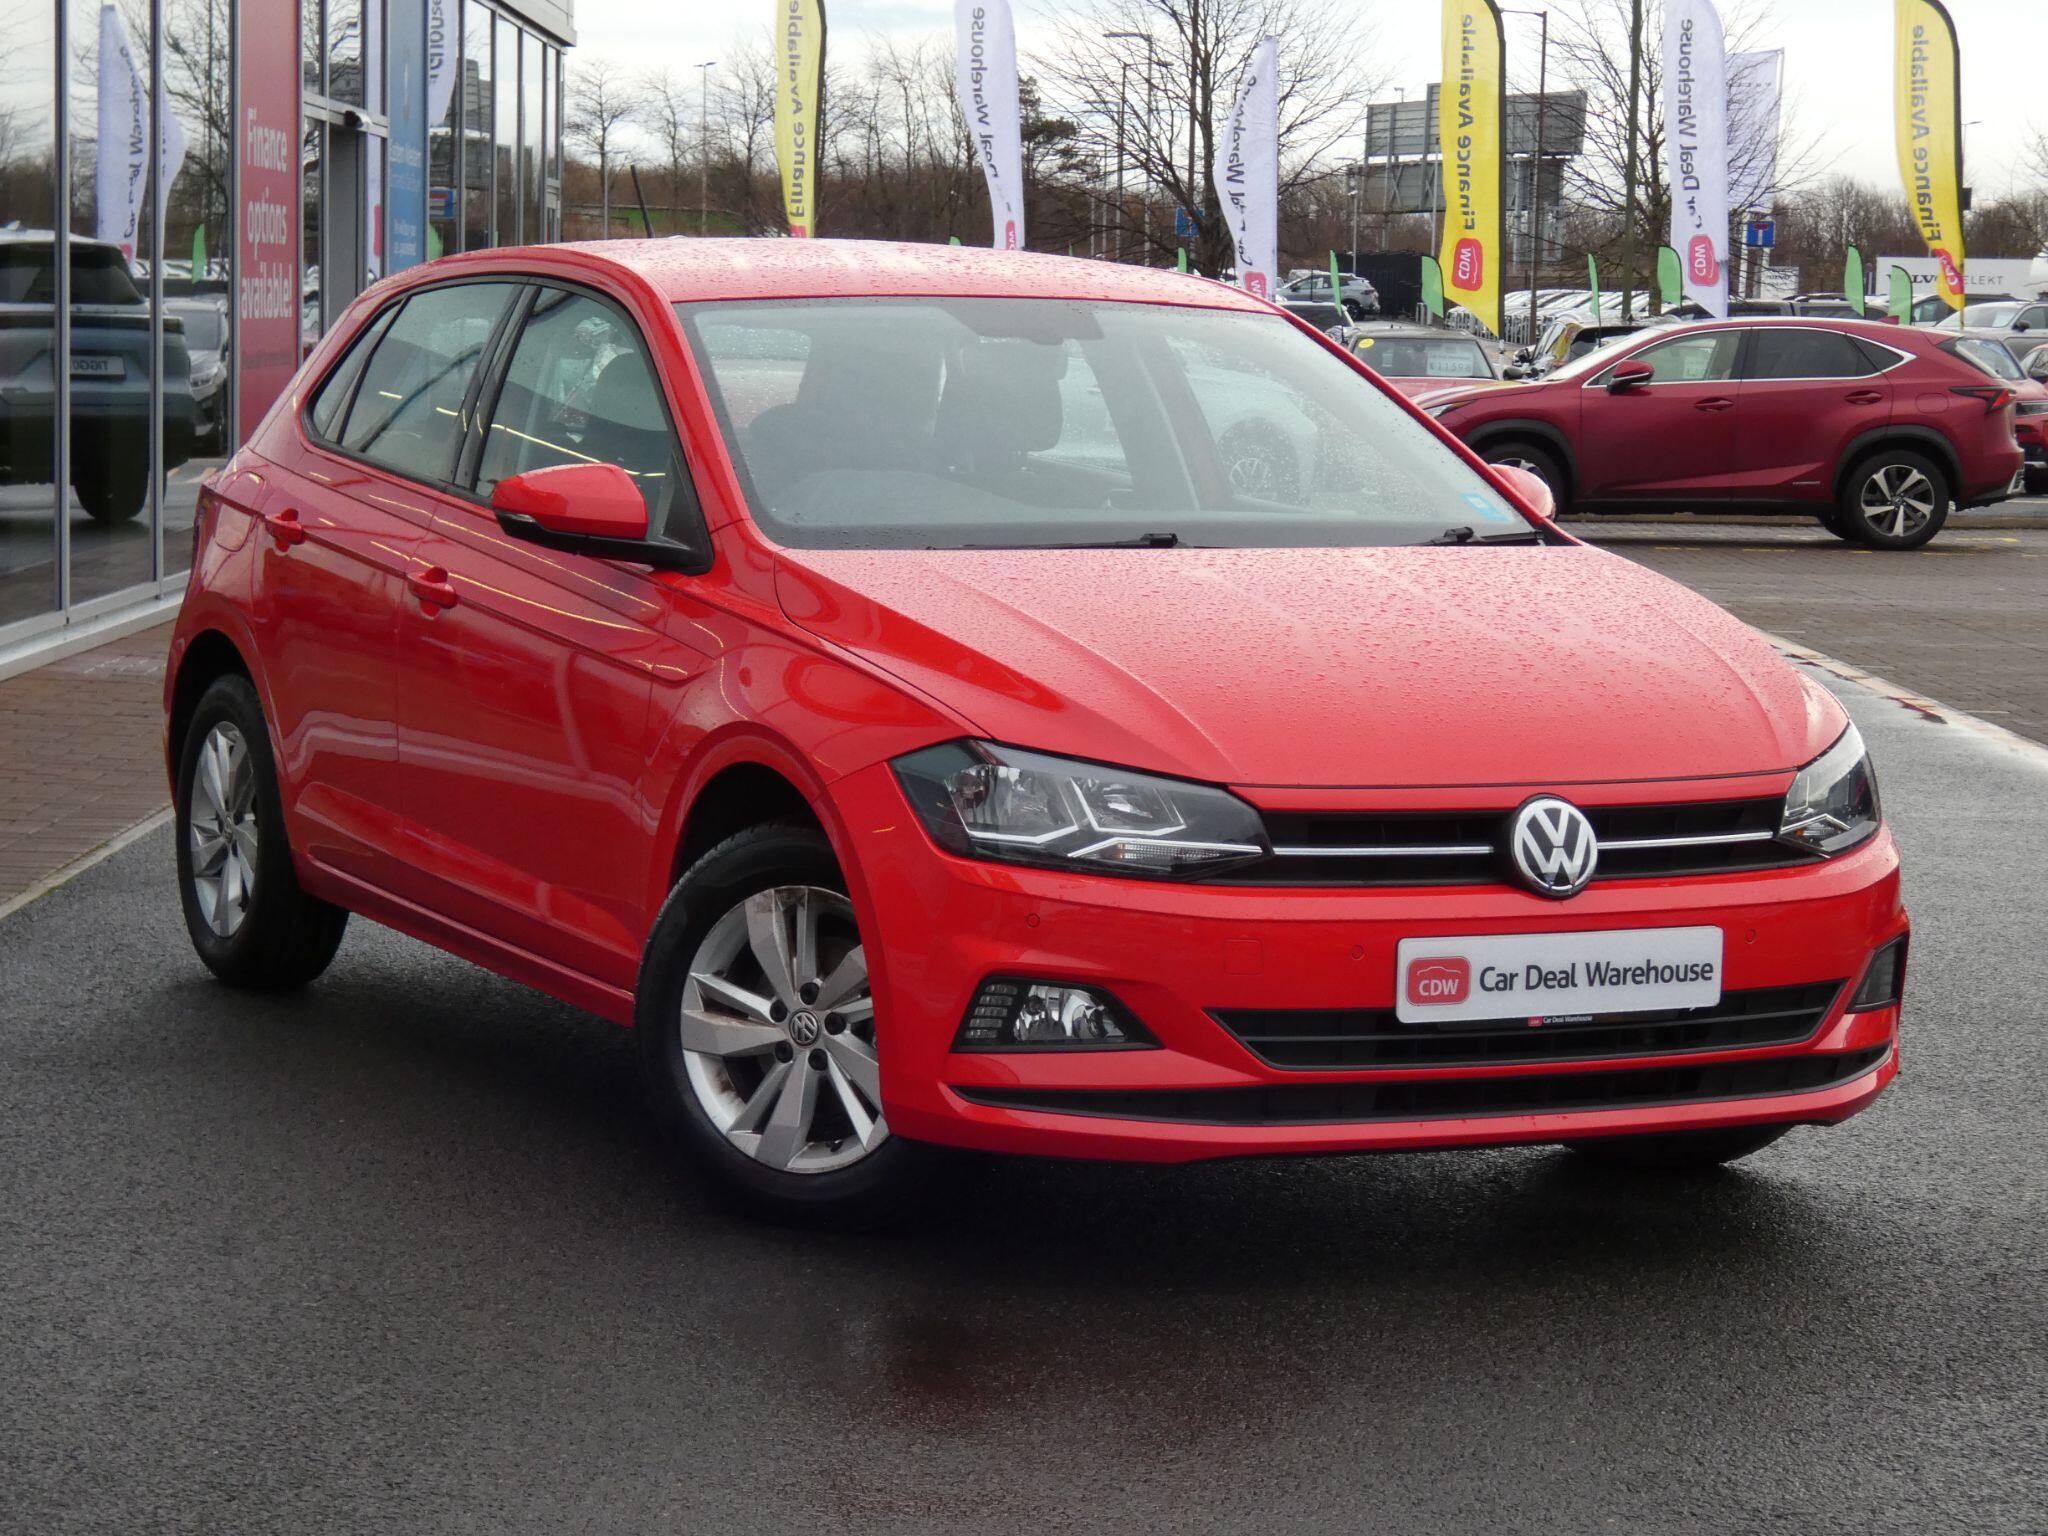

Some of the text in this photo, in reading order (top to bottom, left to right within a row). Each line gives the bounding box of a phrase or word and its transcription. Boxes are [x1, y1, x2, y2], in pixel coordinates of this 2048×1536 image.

[246, 107, 288, 173] Finance
[247, 186, 288, 261] options
[241, 261, 293, 320] available!
[1964, 274, 2004, 285] ELEKT
[1418, 978, 1459, 997] CDW
[1479, 959, 1714, 992] Car Deal Warehouse
